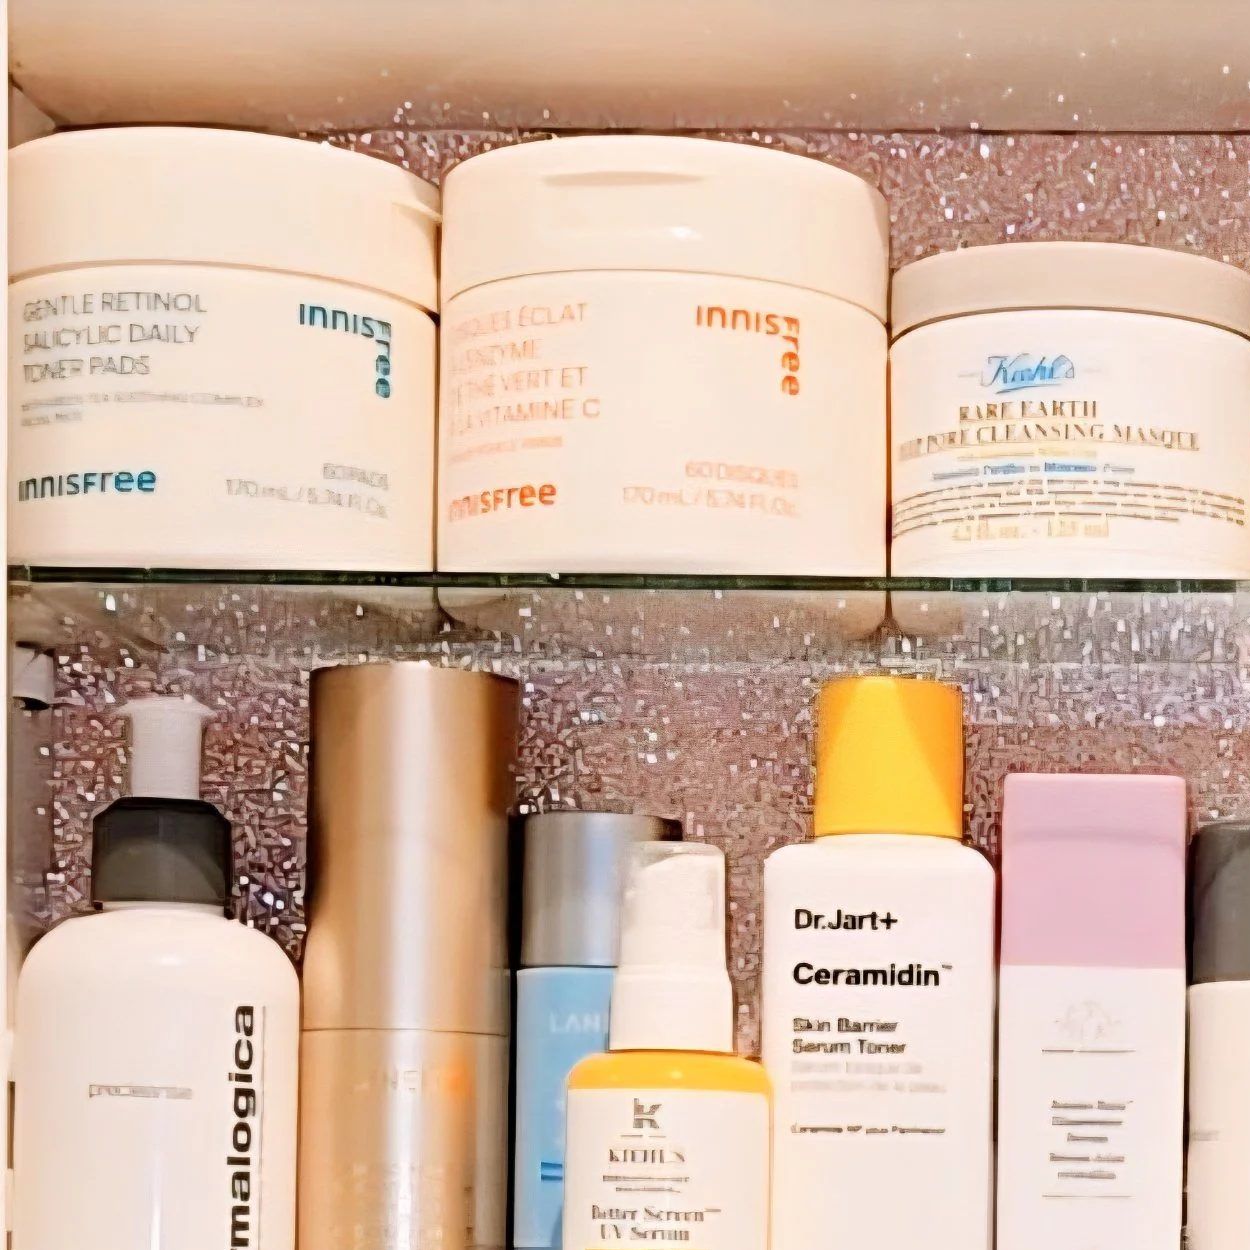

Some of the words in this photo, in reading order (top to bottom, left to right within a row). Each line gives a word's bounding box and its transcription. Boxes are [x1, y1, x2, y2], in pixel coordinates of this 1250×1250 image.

[102, 292, 207, 314] RETINOL
[130, 324, 200, 345] DAILY
[89, 355, 151, 376] PADS
[562, 366, 588, 389] ET
[583, 398, 601, 419] C
[1021, 400, 1097, 419] EARTH
[977, 424, 1104, 443] CLEANSING
[794, 908, 898, 930] Dr.Jart+
[793, 962, 940, 987] Ceramidin
